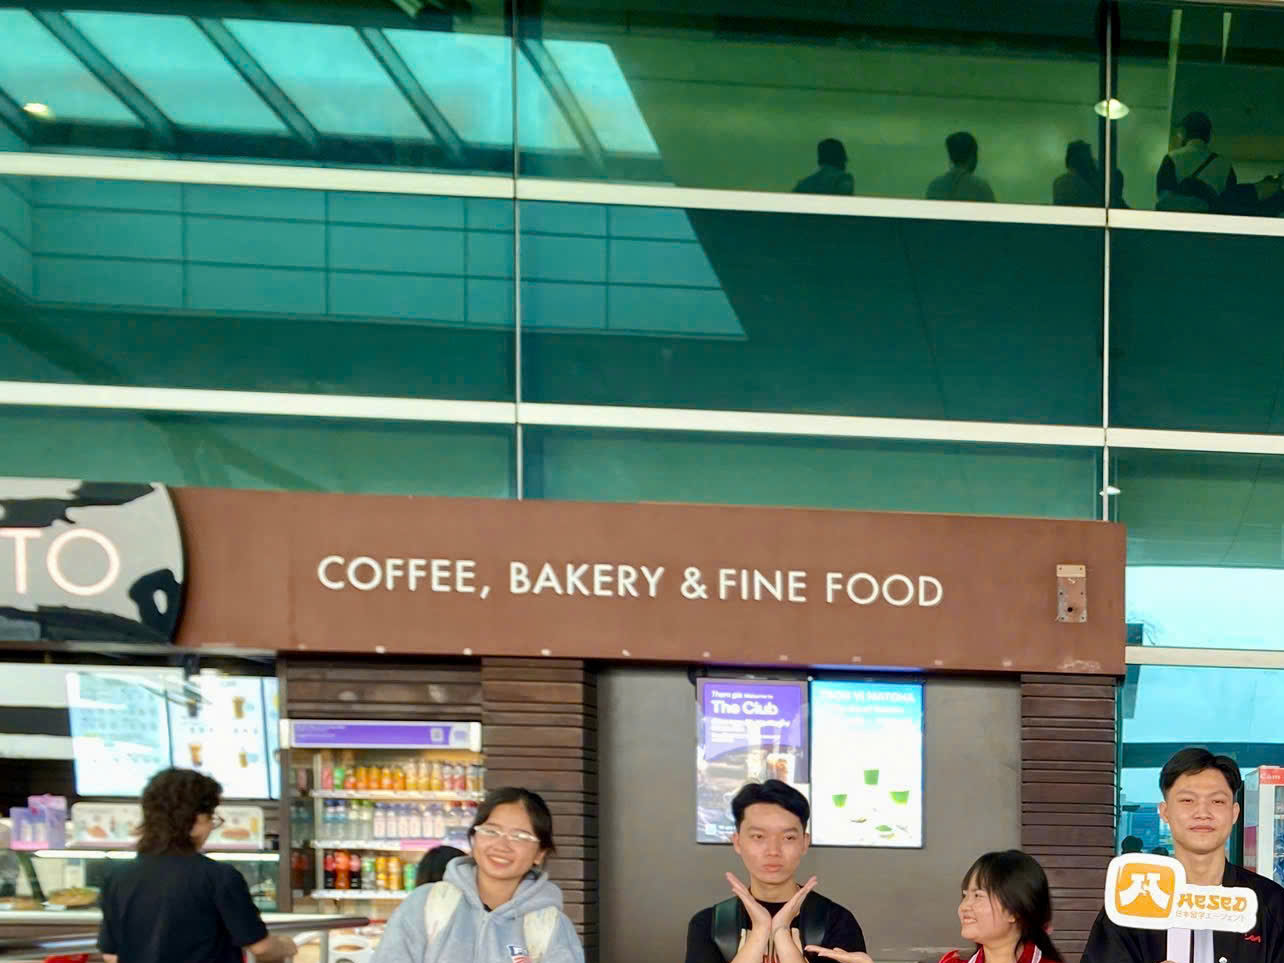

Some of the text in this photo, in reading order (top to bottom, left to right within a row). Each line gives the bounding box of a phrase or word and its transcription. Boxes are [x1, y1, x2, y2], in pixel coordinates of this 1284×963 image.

[317, 555, 943, 607] COFFEE, BAKERY & FINE FOOD
[711, 700, 779, 716] The Club
